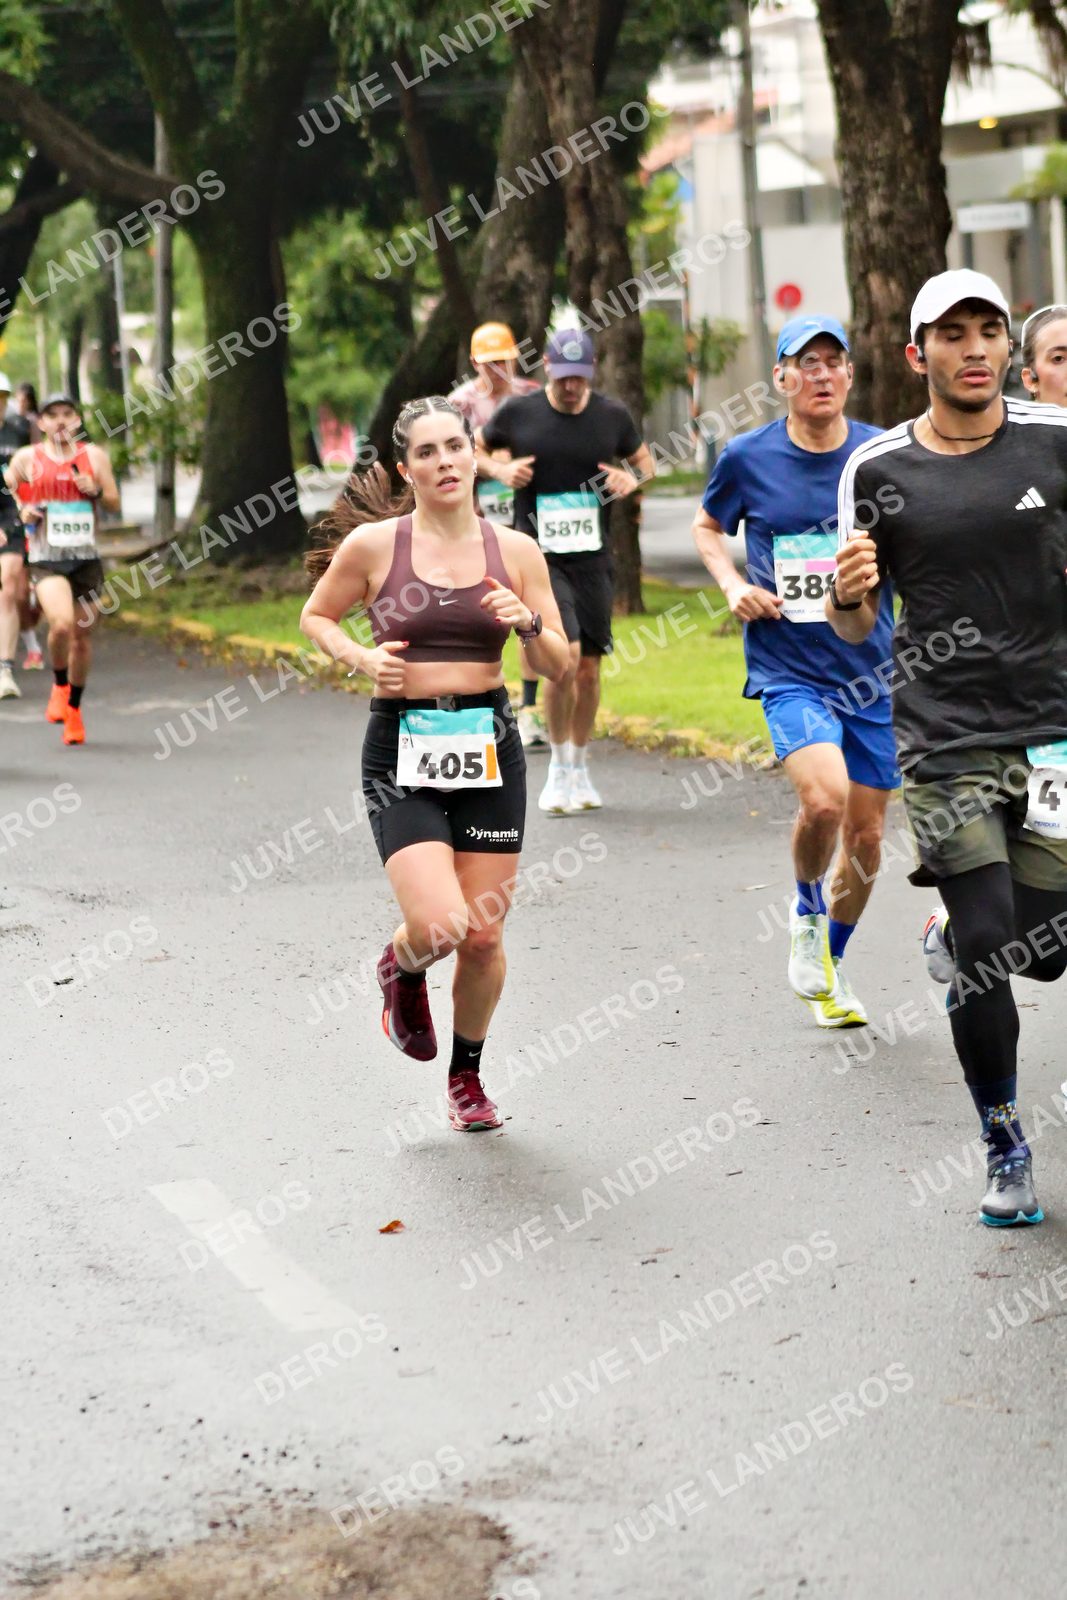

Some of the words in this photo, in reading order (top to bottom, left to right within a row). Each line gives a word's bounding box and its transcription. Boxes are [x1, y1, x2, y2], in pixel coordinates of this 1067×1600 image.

[543, 519, 594, 538] 5876
[416, 751, 484, 780] 405
[1037, 780, 1067, 811] 4
